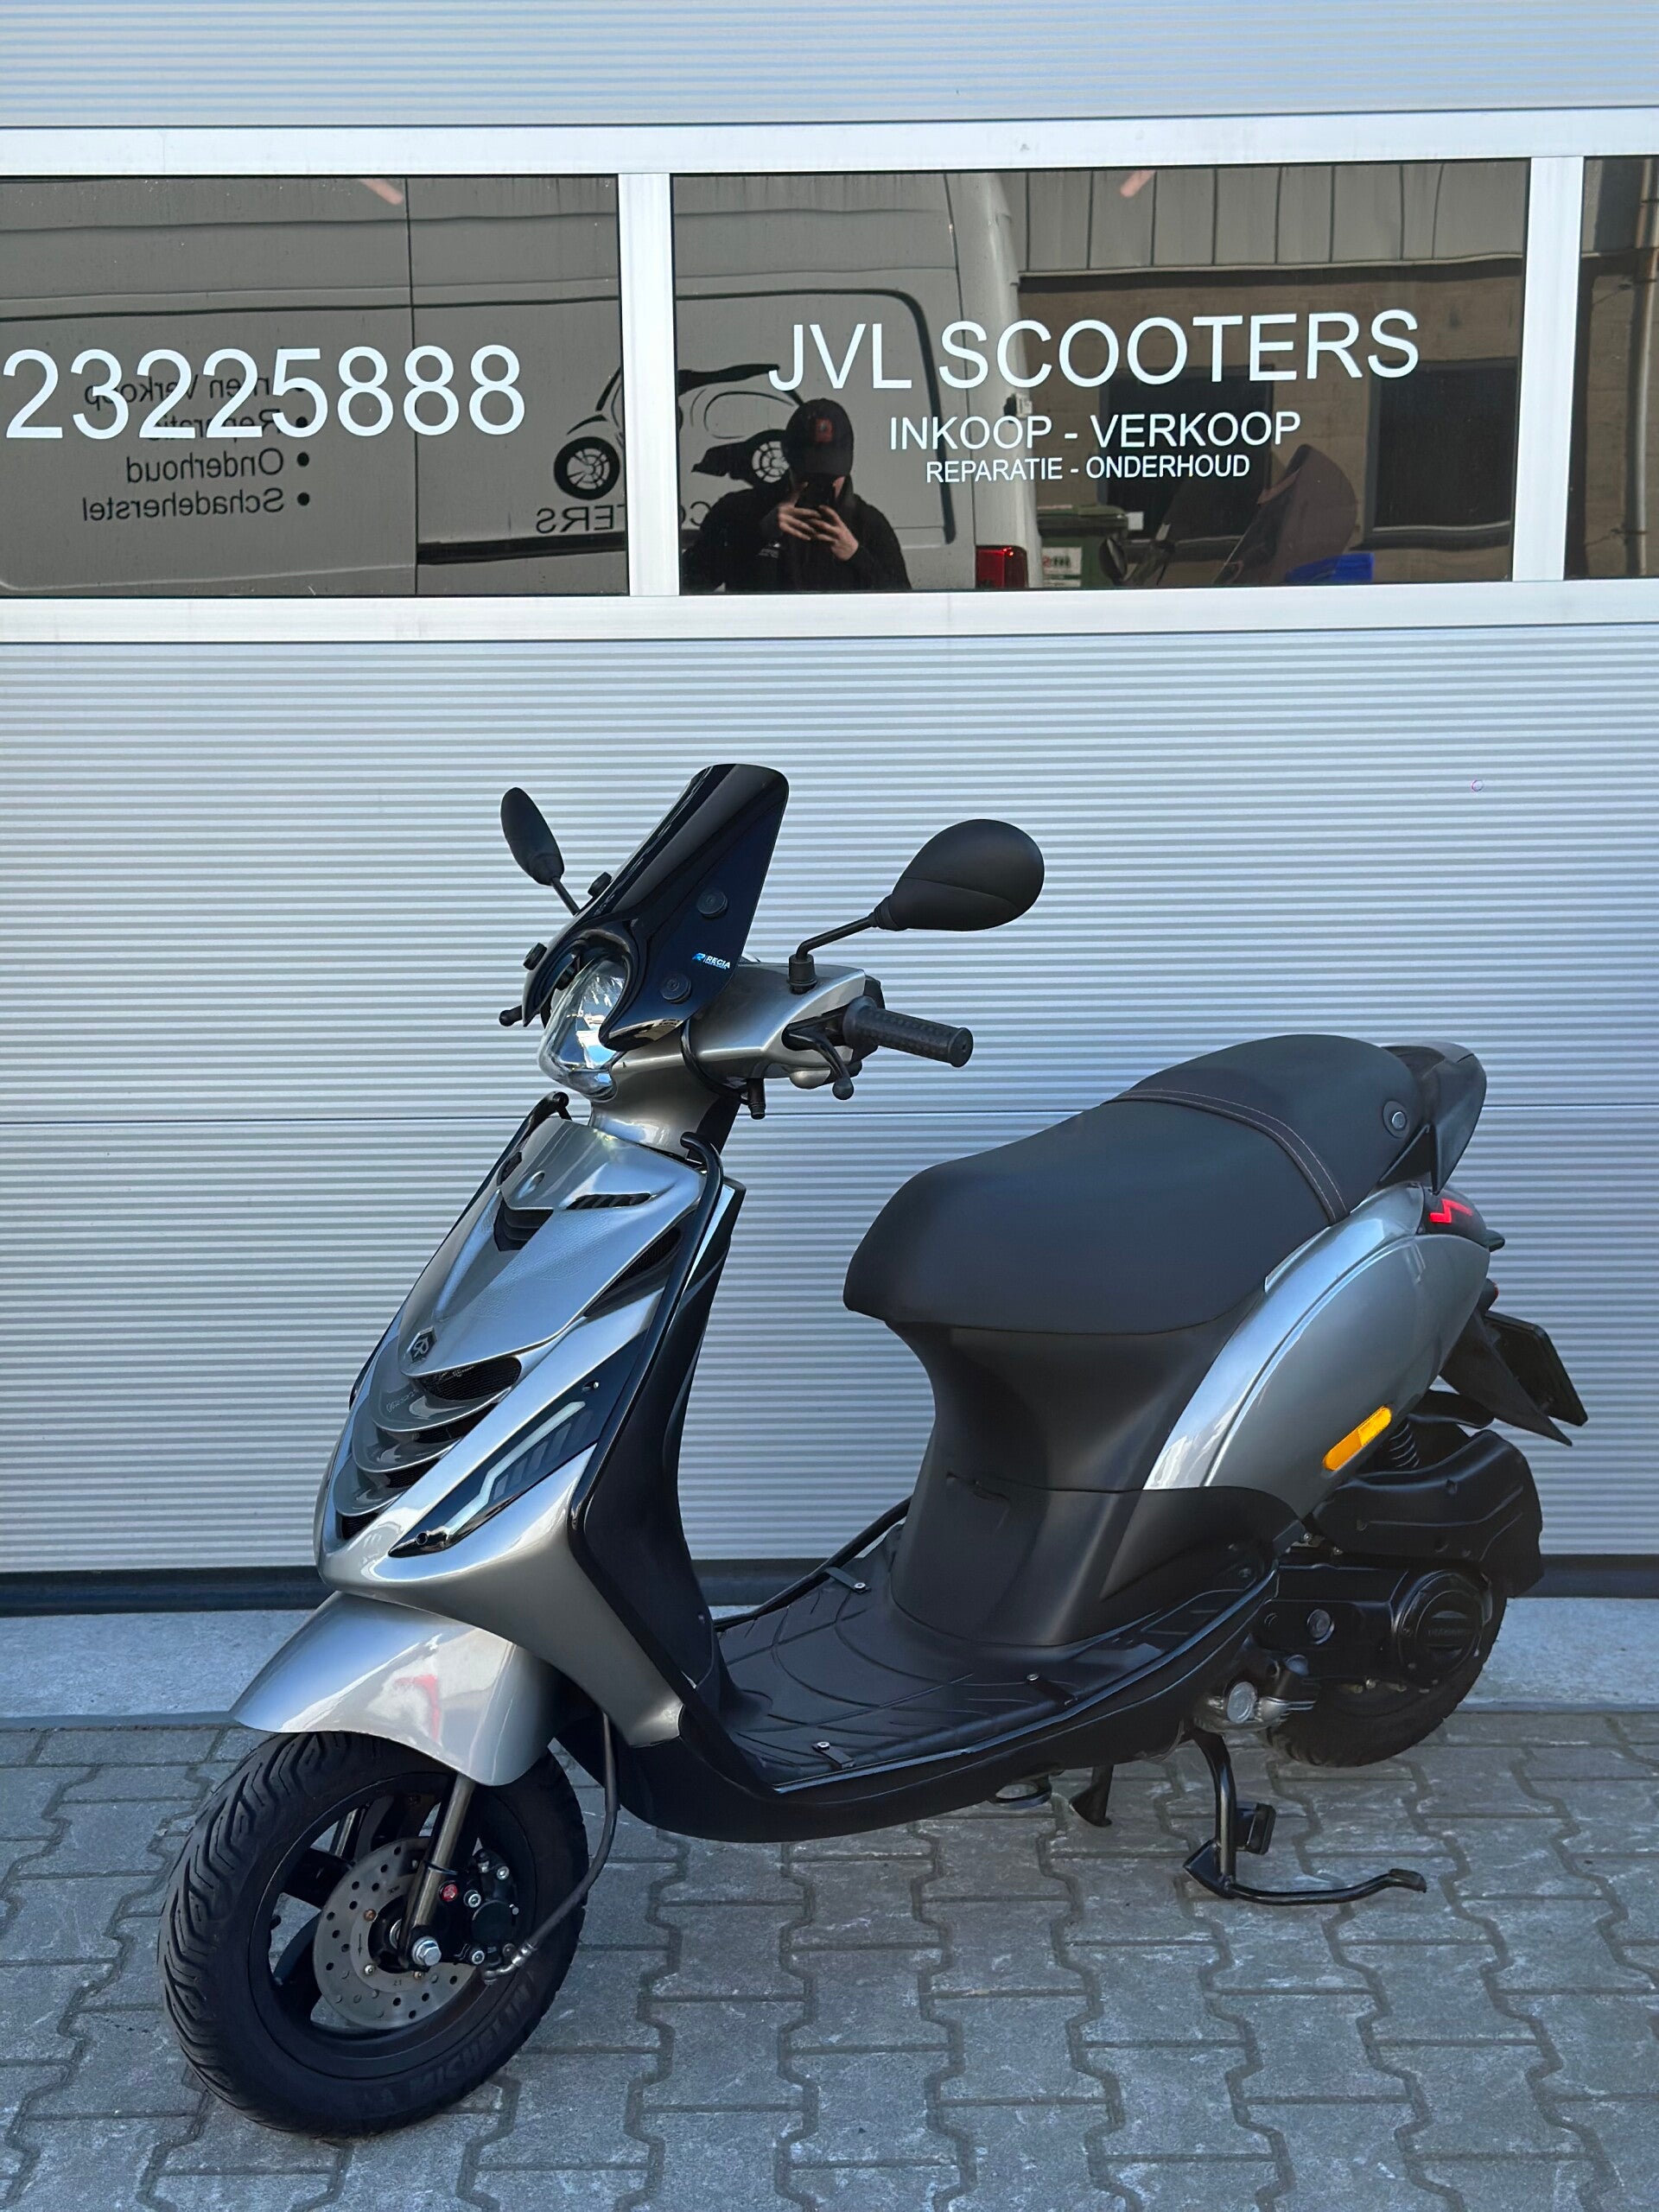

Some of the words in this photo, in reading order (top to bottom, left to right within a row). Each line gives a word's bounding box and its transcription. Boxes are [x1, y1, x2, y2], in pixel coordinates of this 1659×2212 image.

[768, 323, 912, 391] JVL
[938, 309, 1420, 389] SCOOTERS
[3, 344, 525, 440] 23225888
[890, 415, 1052, 450] INKOOP
[1090, 410, 1300, 448] VERKOOP
[926, 457, 1063, 483] REPARATIE
[1086, 454, 1250, 479] ONDERHOUD
